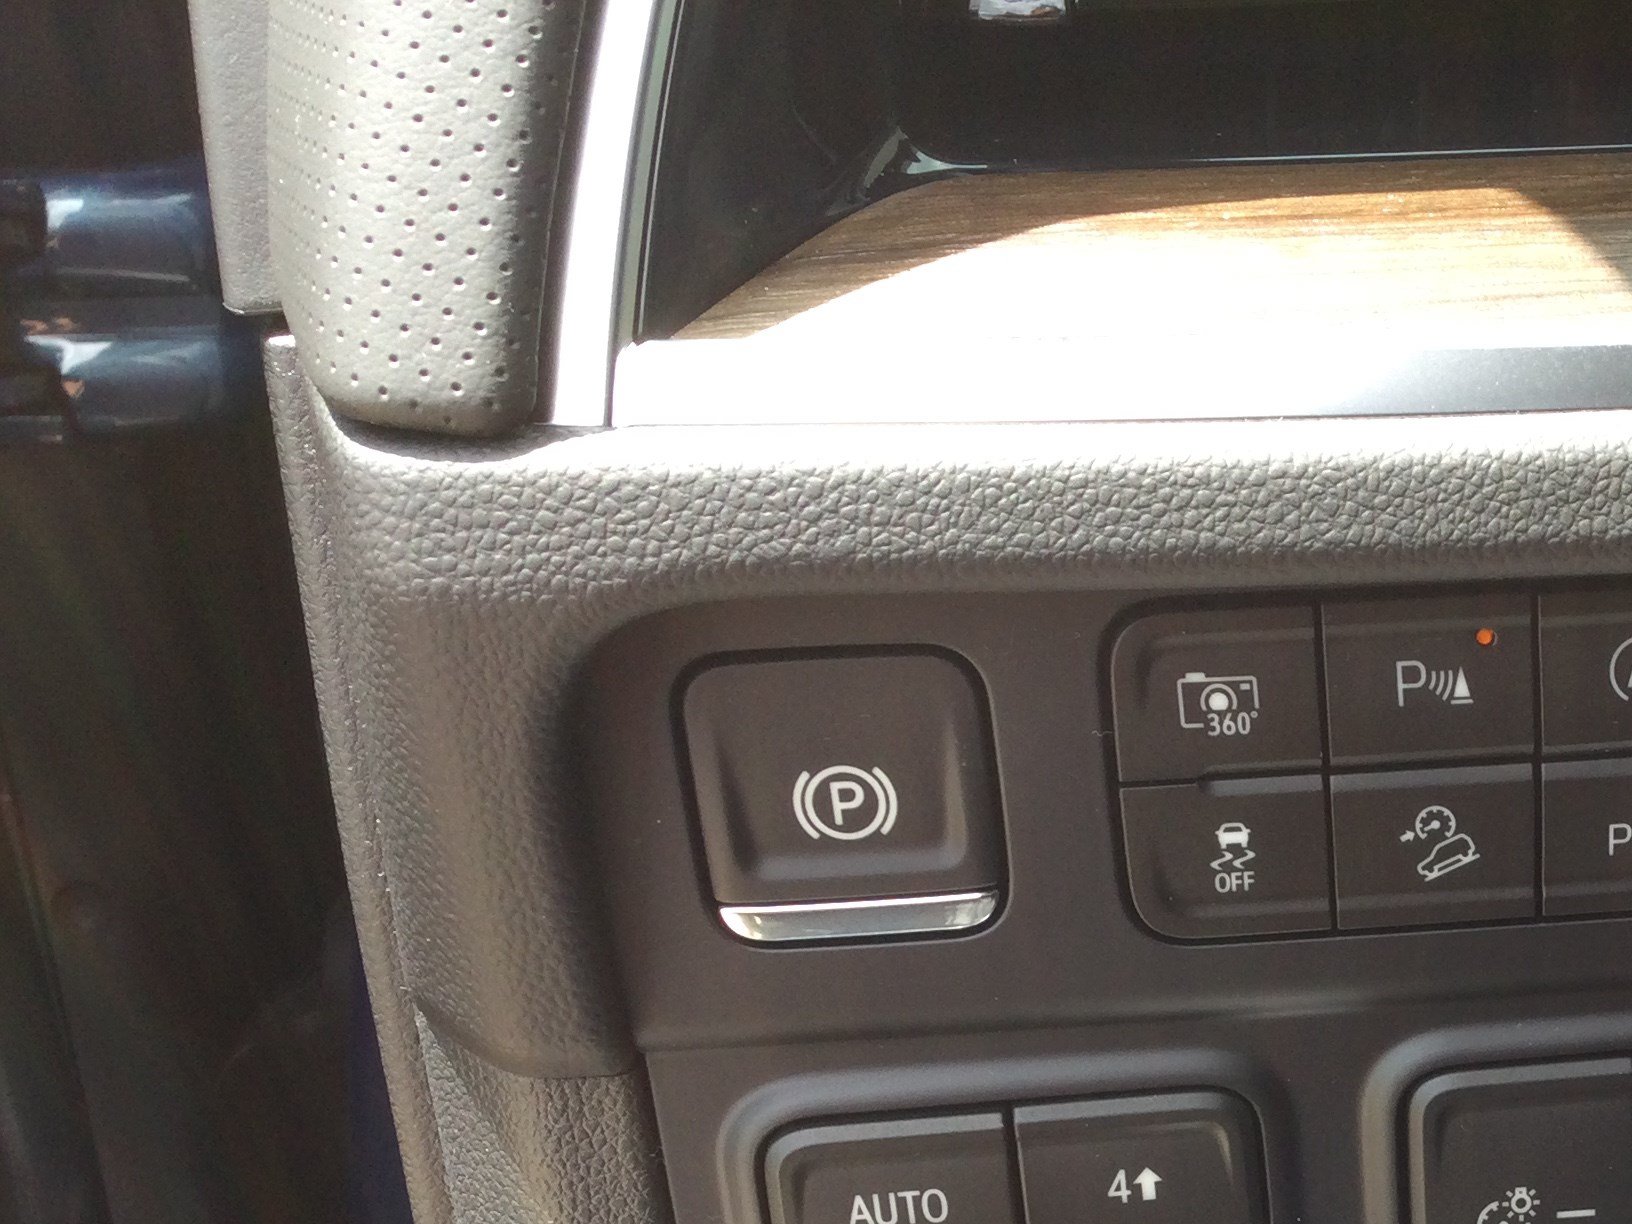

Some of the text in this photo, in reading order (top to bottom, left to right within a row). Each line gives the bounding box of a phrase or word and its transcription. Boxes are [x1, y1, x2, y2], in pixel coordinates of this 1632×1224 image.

[828, 780, 864, 825] P
[1214, 871, 1255, 893] OFF
[1107, 1169, 1132, 1204] 4
